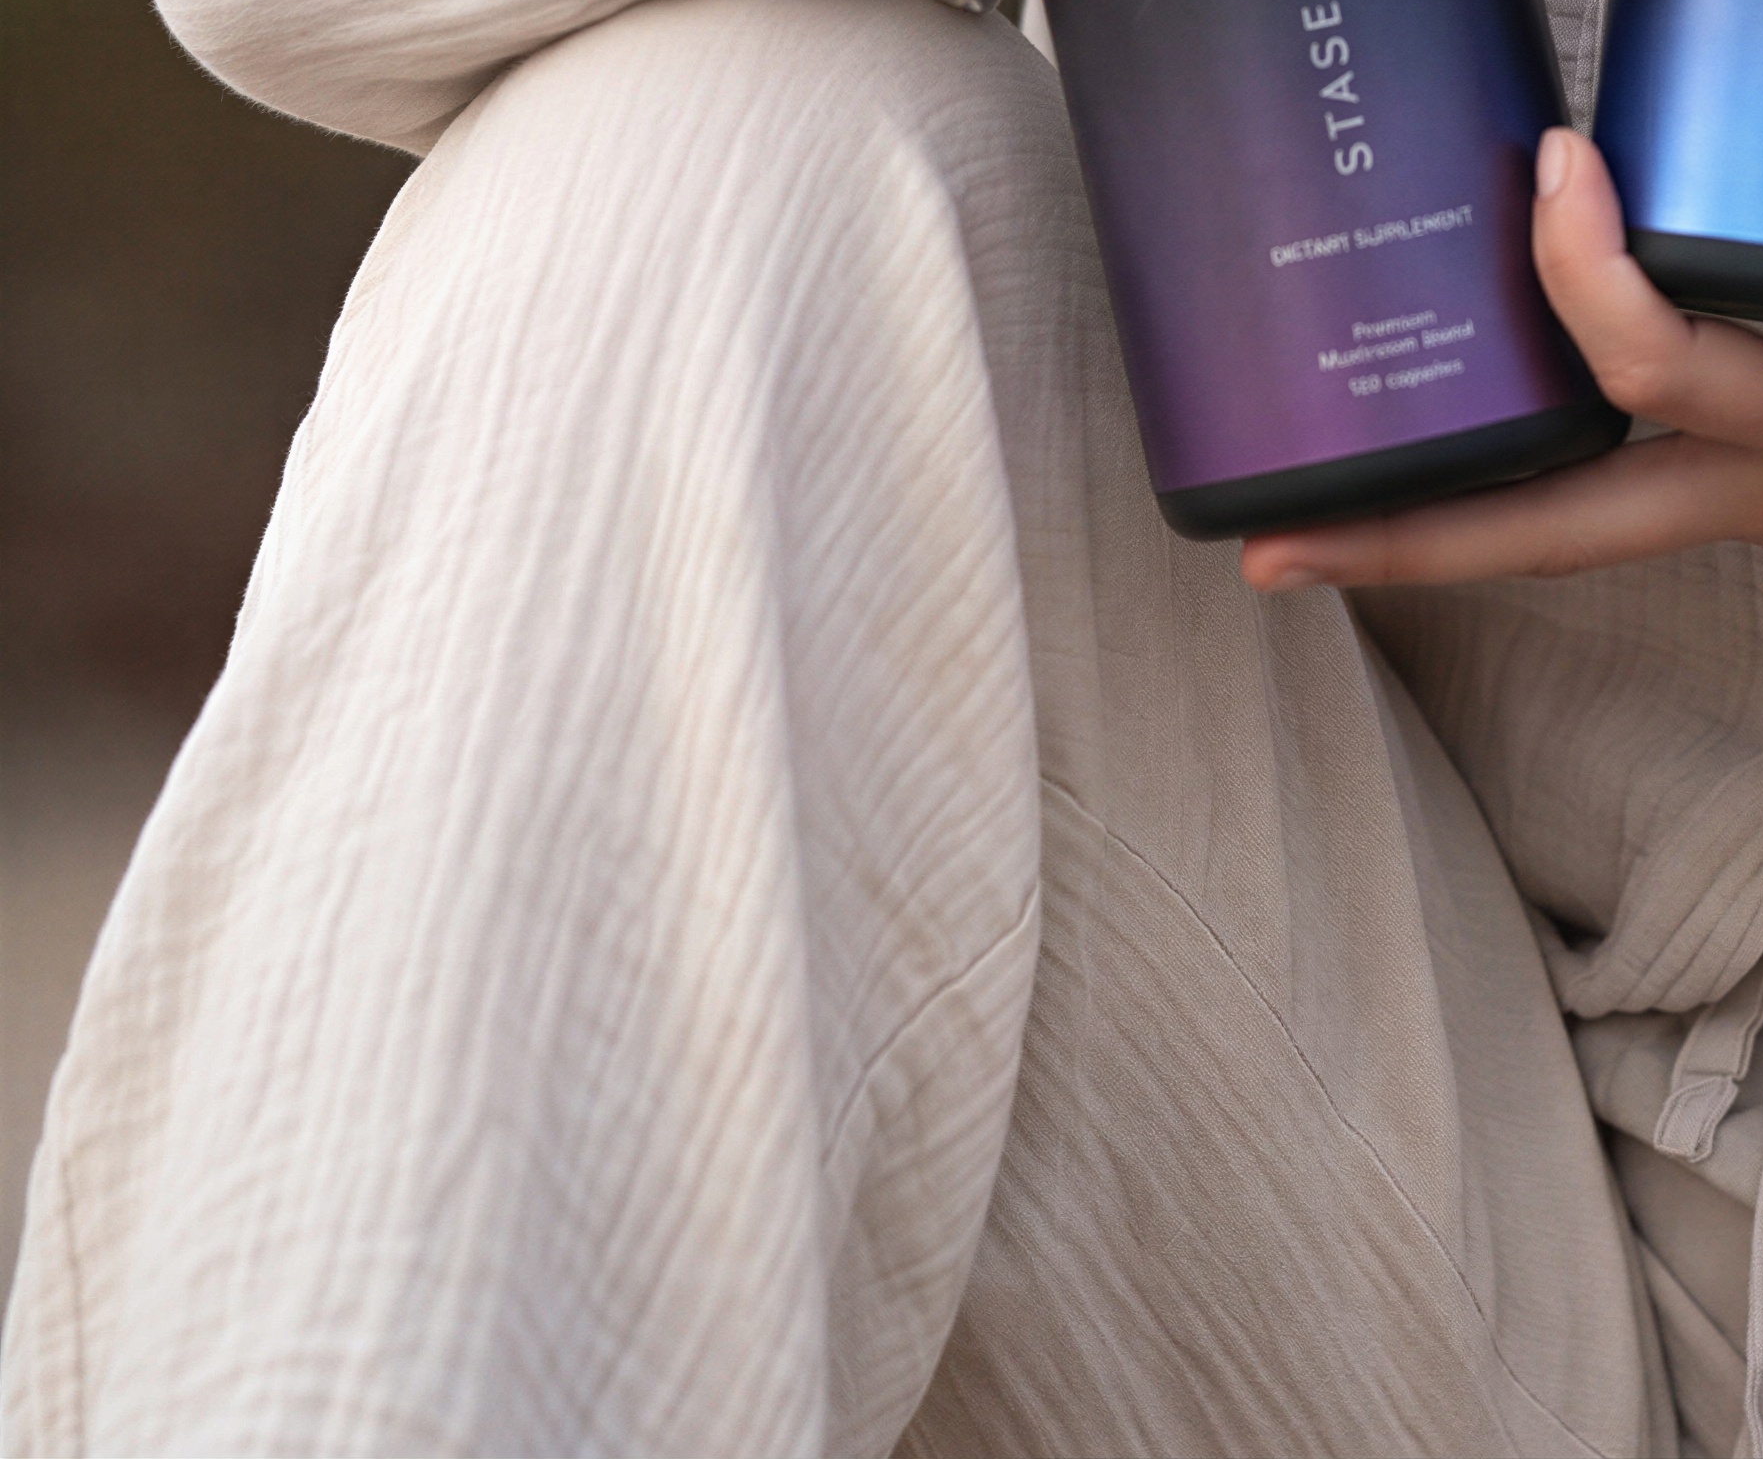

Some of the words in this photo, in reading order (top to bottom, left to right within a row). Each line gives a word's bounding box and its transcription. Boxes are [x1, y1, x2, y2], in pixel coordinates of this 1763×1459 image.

[1300, 0, 1374, 176] STASE
[1270, 232, 1350, 267] DIETARY
[1353, 204, 1473, 249] SUPPLEMENT
[1352, 309, 1438, 342] Premium
